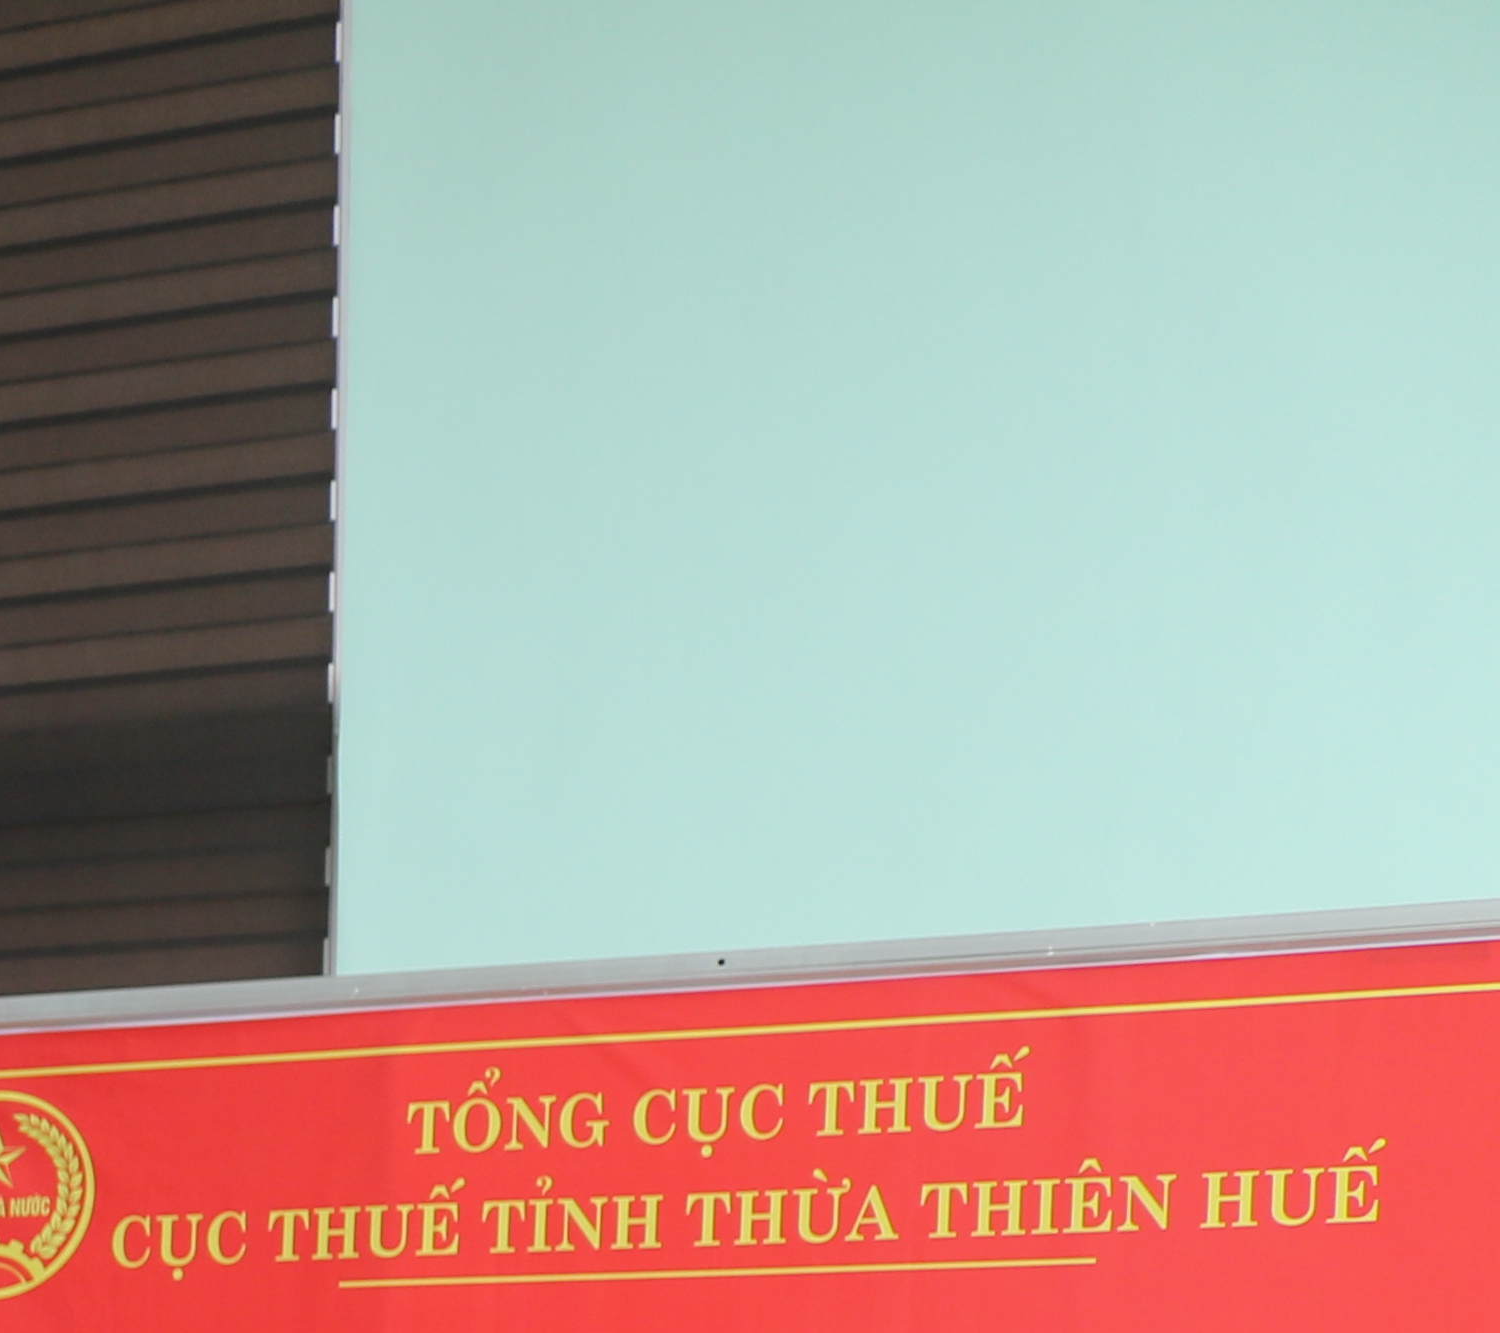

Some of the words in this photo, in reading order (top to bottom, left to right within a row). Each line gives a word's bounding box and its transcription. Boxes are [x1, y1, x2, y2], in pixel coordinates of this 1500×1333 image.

[407, 1068, 609, 1154] TỔNG
[633, 1084, 783, 1157] CỤC
[809, 1046, 1030, 1136] THUẾ
[112, 1212, 246, 1280] CỤC
[269, 1178, 465, 1261] THUẾ
[482, 1176, 663, 1253] TỈNH
[686, 1169, 898, 1246] THỪA
[921, 1158, 1177, 1238] THIÊN
[1200, 1138, 1386, 1228] HUẾ
